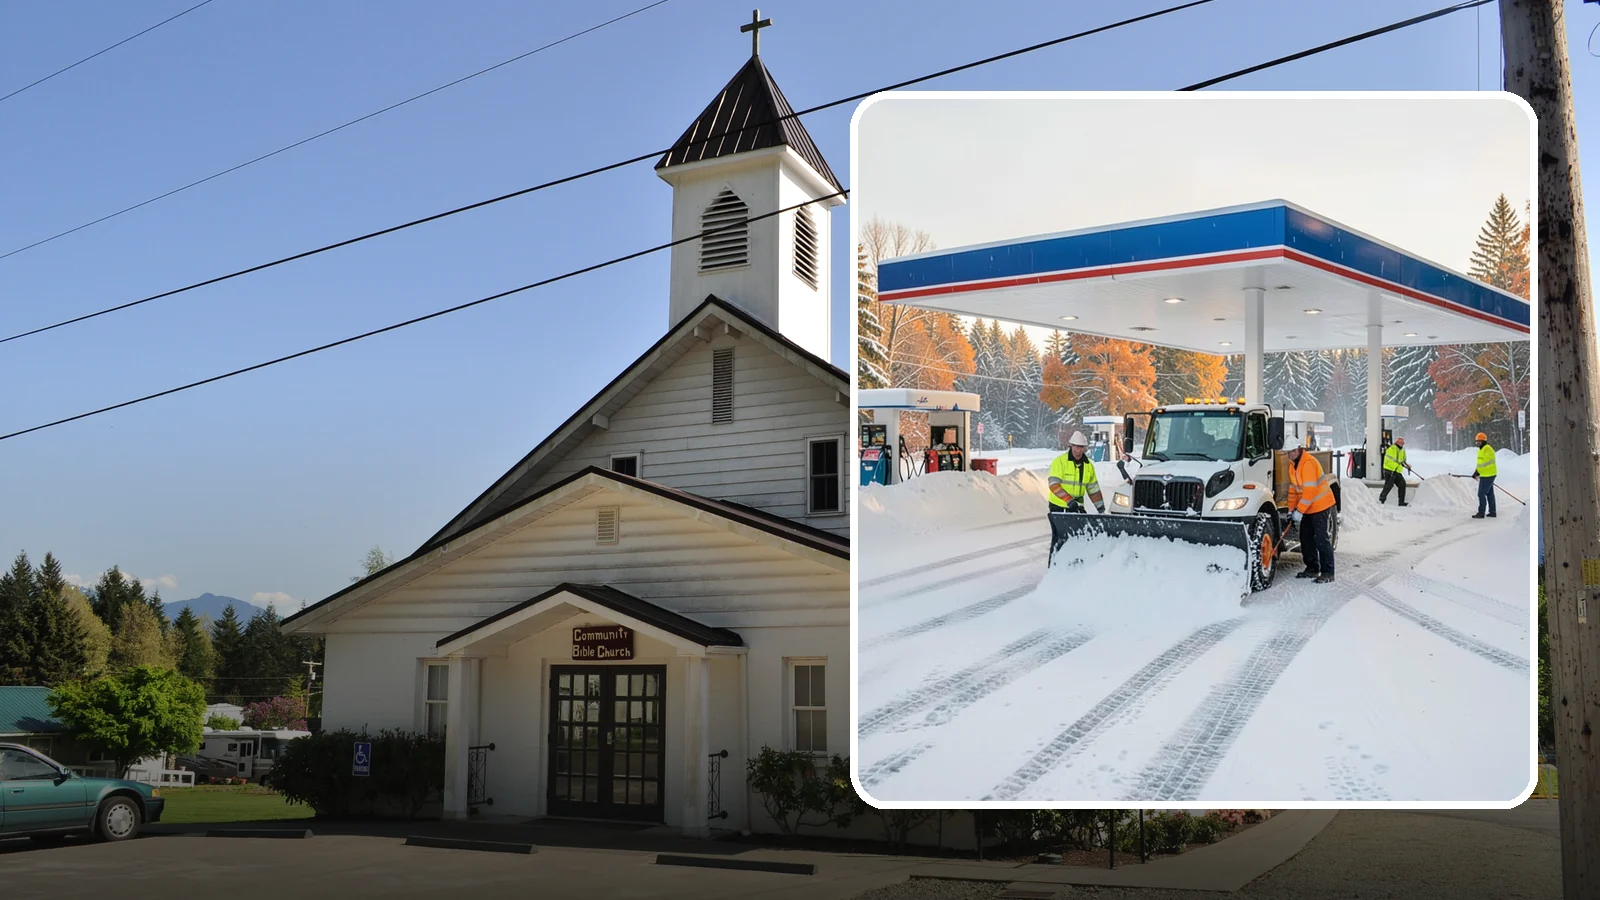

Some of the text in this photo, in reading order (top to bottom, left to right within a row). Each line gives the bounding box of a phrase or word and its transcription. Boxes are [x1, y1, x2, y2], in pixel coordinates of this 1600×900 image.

[574, 627, 628, 641] Community
[572, 644, 631, 658] Bible Church
